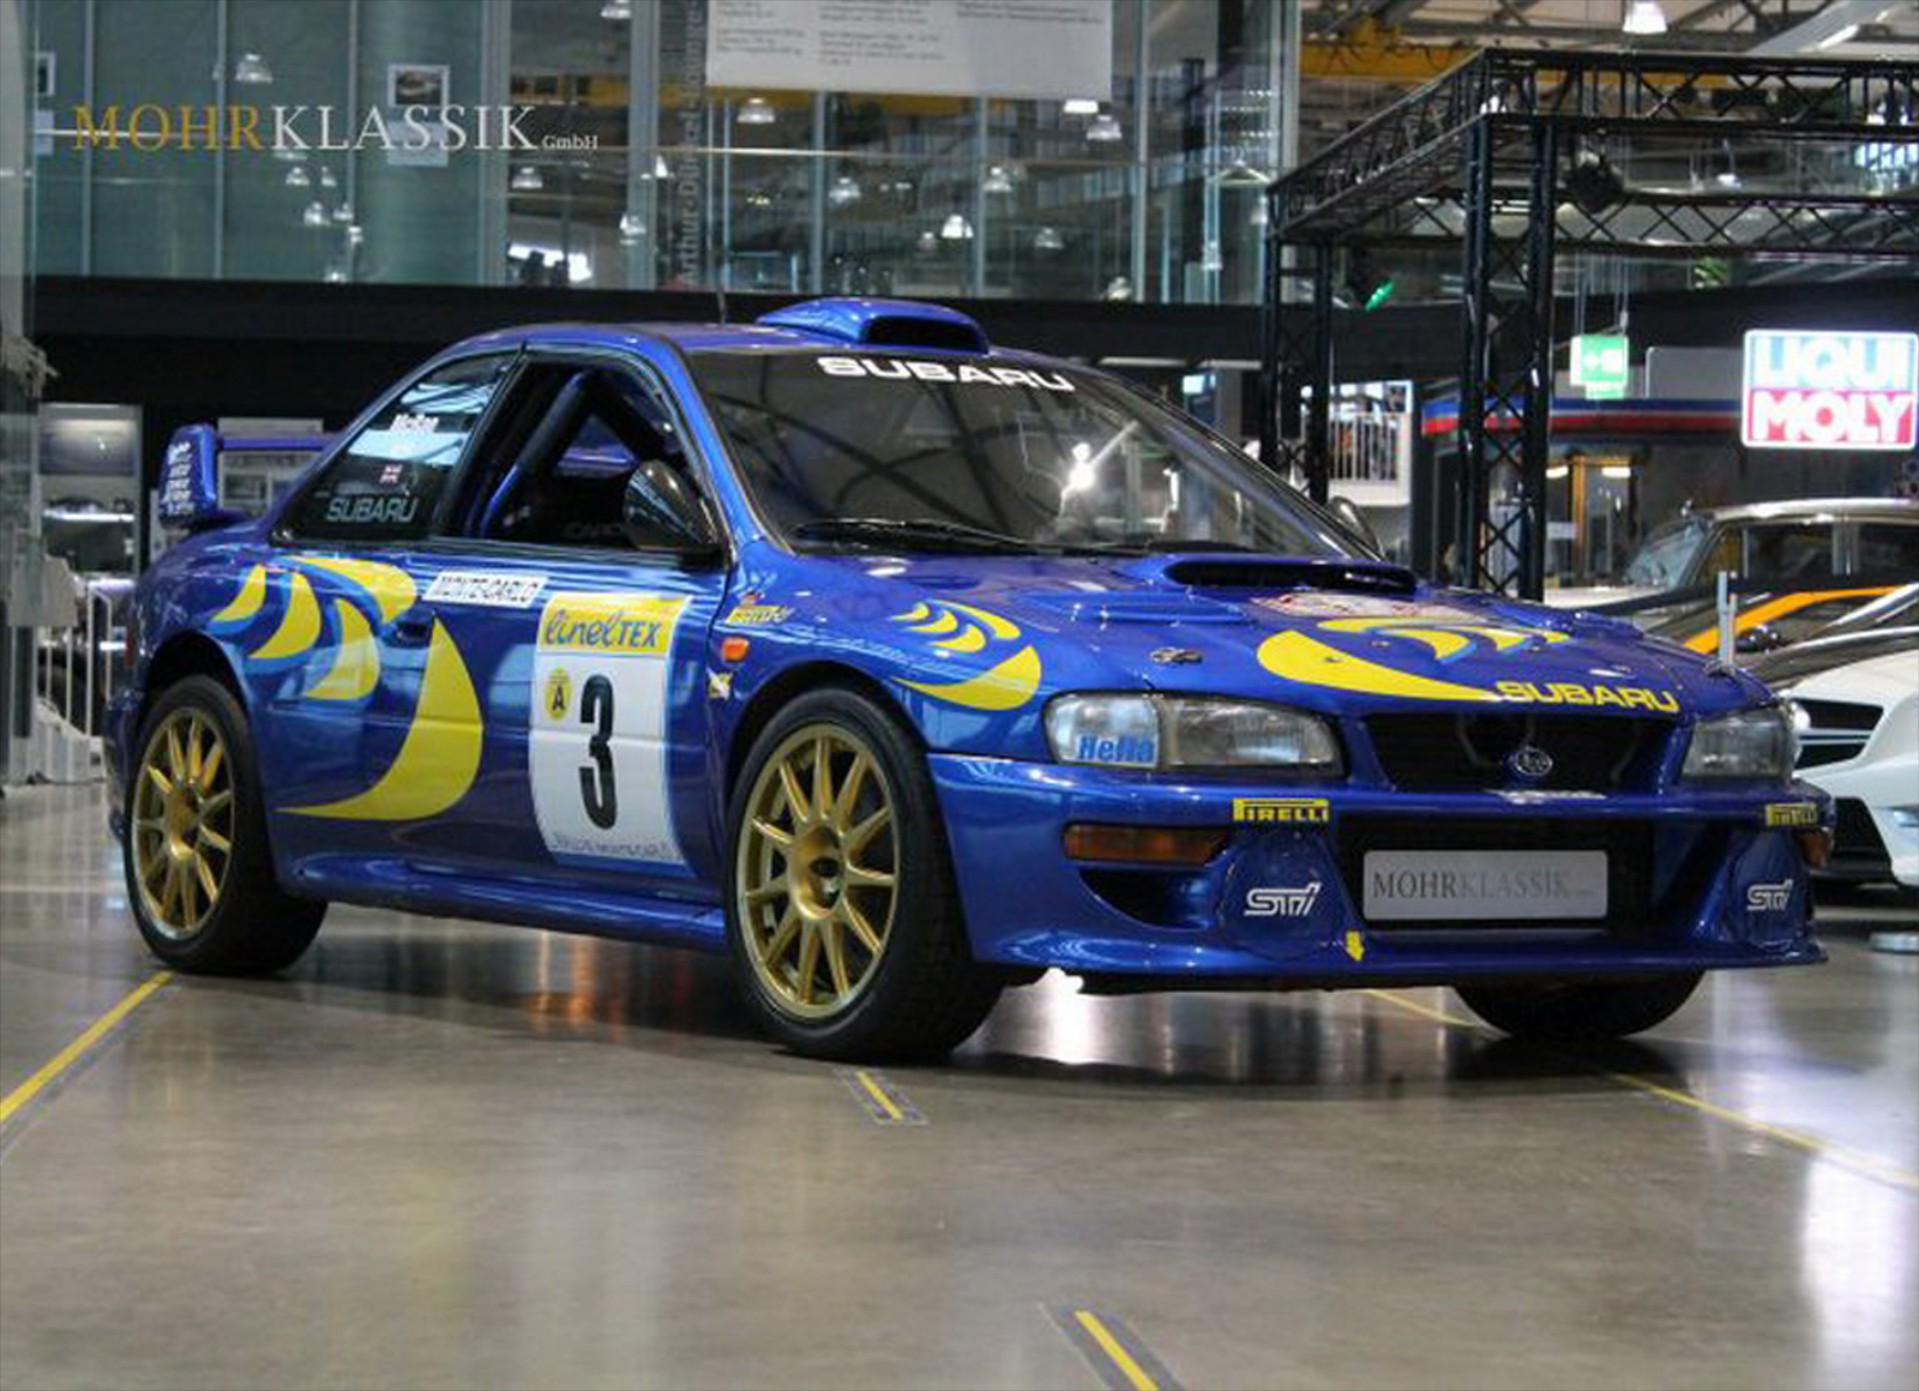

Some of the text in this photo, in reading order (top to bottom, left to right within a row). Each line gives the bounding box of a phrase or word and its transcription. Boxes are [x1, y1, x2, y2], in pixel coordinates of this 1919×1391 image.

[817, 356, 1076, 392] SUBARU
[1752, 334, 1910, 389] LIQUI
[1752, 390, 1913, 442] MOLY
[326, 498, 419, 523] SUBARU
[552, 685, 565, 711] A
[1496, 681, 1681, 713] SUBARU
[578, 673, 618, 831] 3
[1233, 798, 1329, 821] PIRELLI
